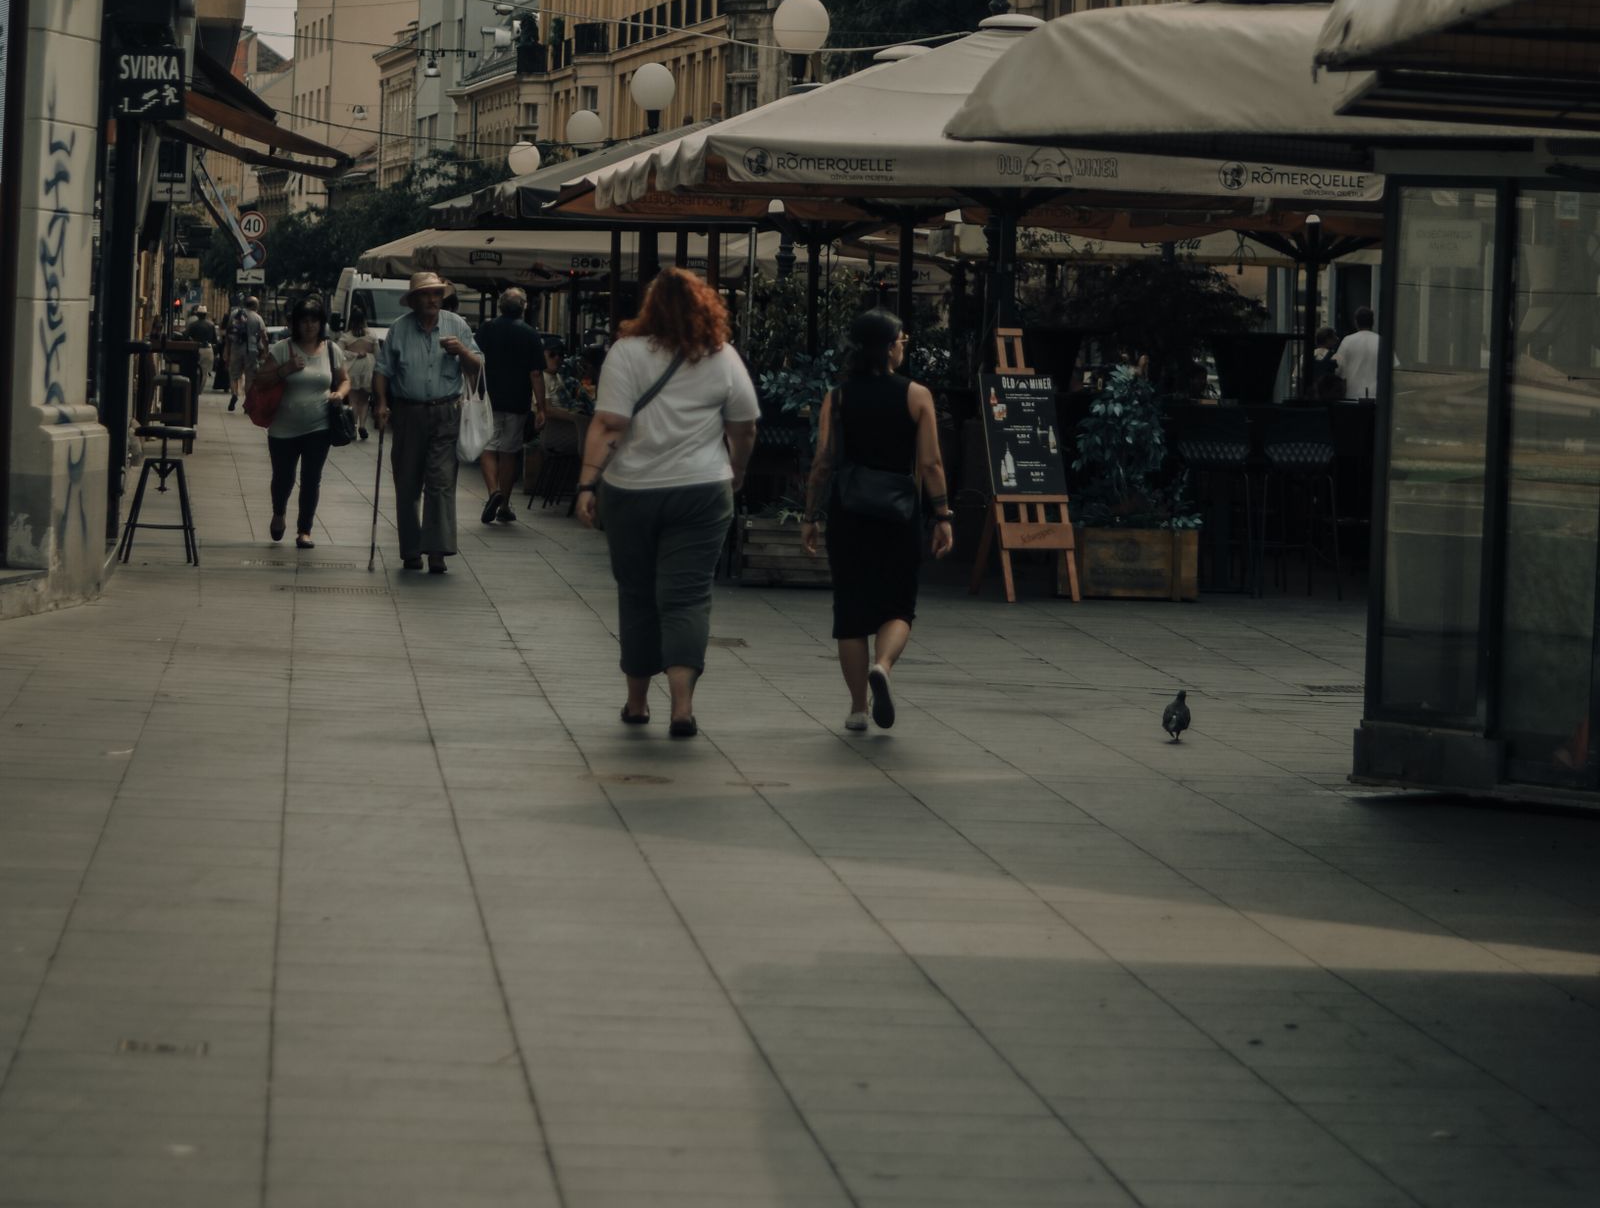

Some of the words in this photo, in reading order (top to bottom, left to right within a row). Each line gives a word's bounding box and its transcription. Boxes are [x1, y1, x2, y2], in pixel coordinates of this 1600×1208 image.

[119, 54, 180, 81] SVIRKA
[997, 153, 1022, 175] OLD
[1074, 156, 1119, 178] MINER
[244, 218, 261, 233] 40
[1001, 376, 1016, 389] OLD
[1029, 377, 1052, 390] MINER
